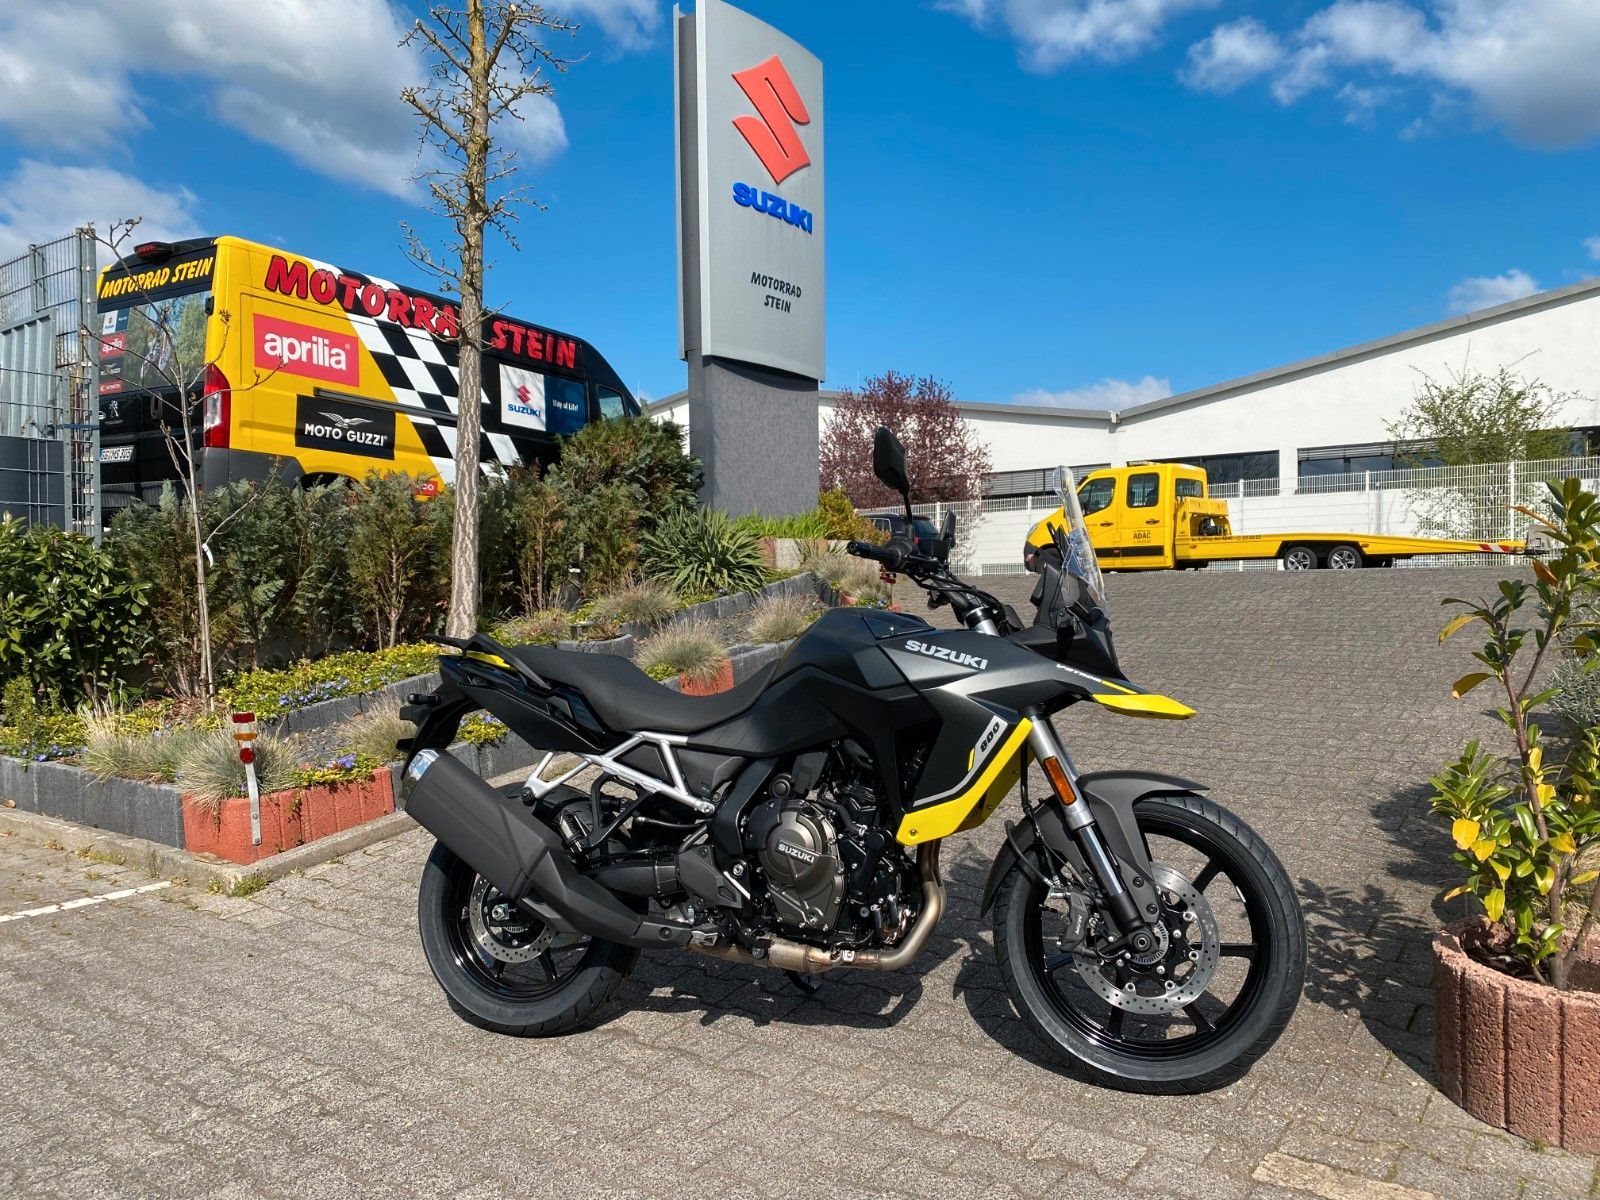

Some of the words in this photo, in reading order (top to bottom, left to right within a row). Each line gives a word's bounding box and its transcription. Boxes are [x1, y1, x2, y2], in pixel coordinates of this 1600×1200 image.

[733, 182, 813, 235] SUZUKI
[171, 256, 214, 283] STEIN
[750, 271, 802, 298] MOTORRAD
[264, 254, 463, 338] MOTORRA
[490, 321, 576, 369] STEIN
[764, 294, 792, 313] STEIN
[263, 332, 347, 371] aprilia
[507, 403, 542, 417] SUZUKI
[304, 422, 343, 440] MOTO
[1133, 532, 1152, 540] ADAC
[904, 639, 989, 670] SUZUKI
[980, 721, 1000, 753] 800
[778, 843, 815, 863] SUZUKI
